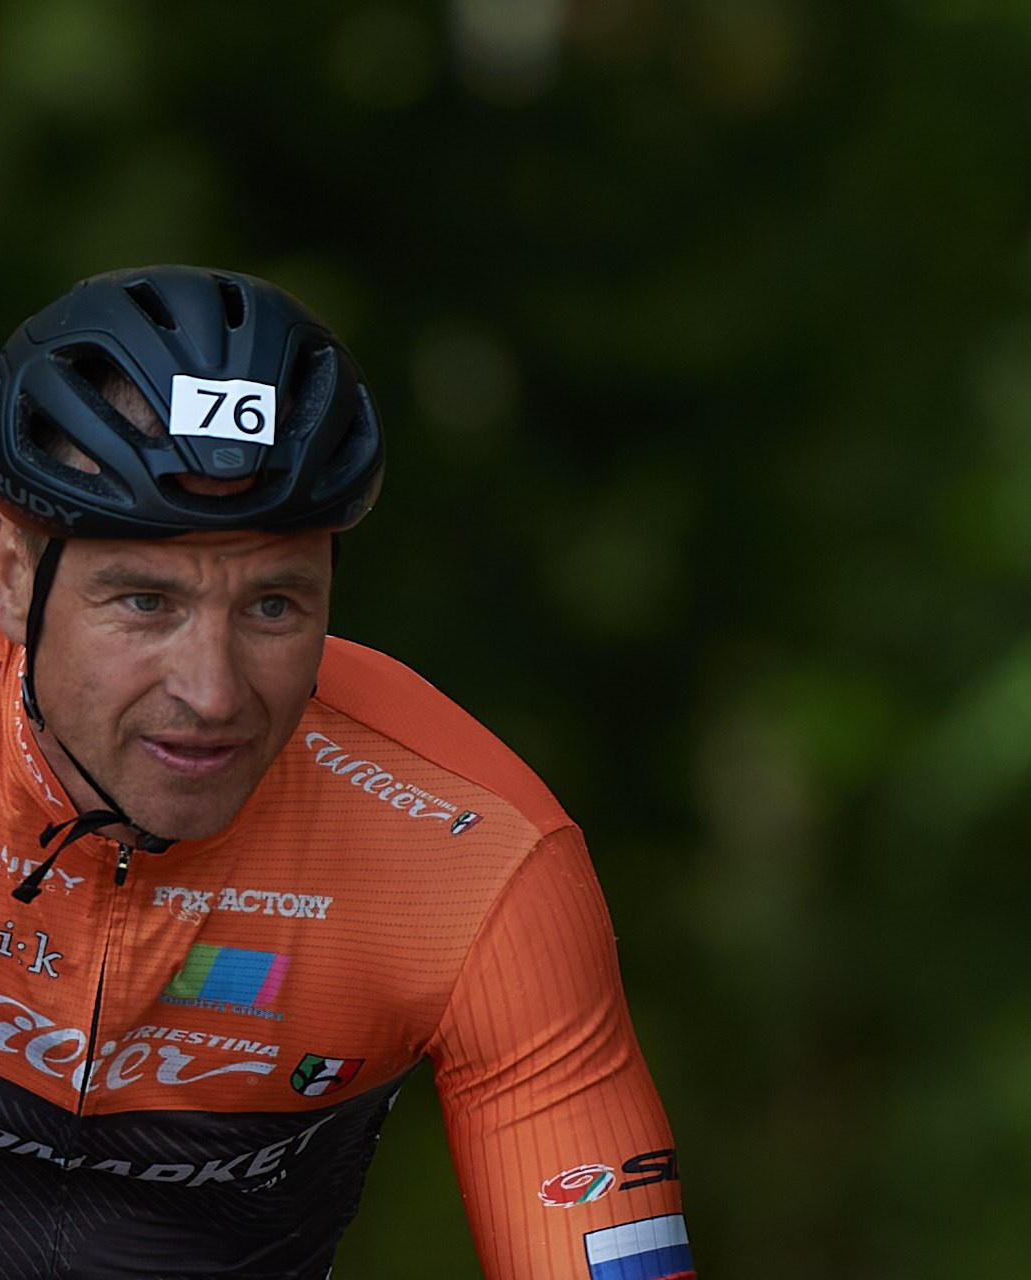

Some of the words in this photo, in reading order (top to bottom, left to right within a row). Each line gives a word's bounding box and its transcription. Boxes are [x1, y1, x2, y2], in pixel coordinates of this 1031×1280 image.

[196, 388, 266, 435] 76
[305, 731, 453, 821] Wilier
[122, 1025, 281, 1059] TRIESTINA
